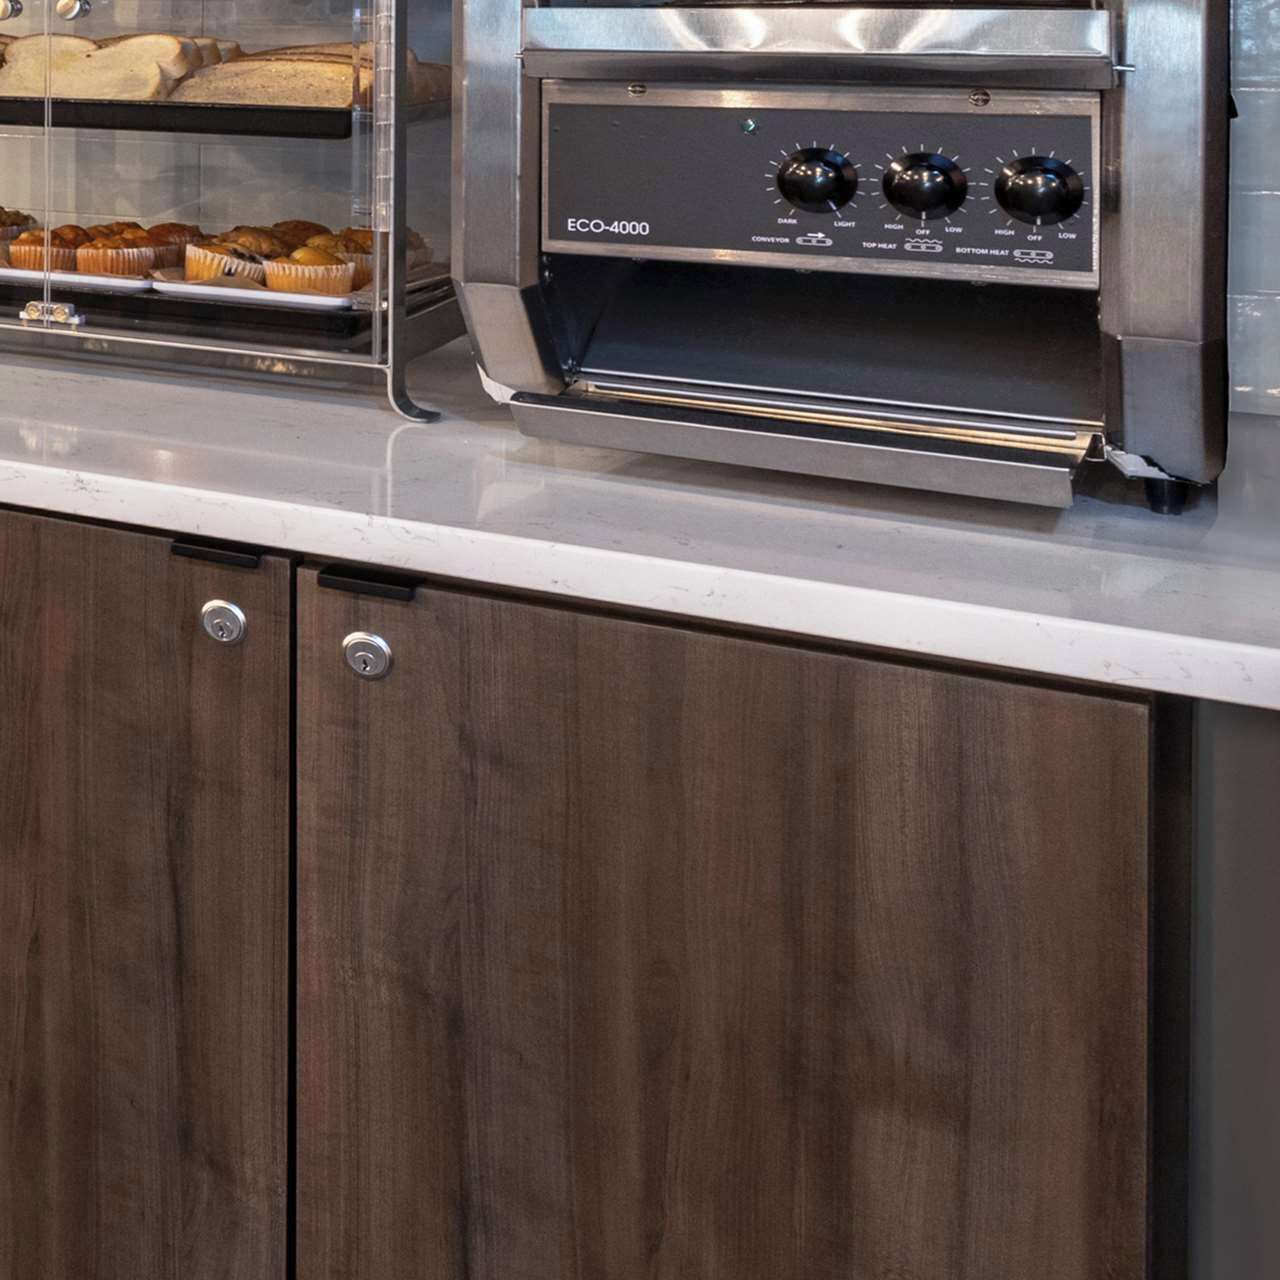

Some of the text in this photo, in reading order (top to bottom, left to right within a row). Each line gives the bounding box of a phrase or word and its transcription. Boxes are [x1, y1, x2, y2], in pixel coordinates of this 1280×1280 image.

[567, 218, 649, 235] ECO-4000
[751, 235, 790, 244] CONVEYOR
[955, 247, 988, 255] BOTTOM
